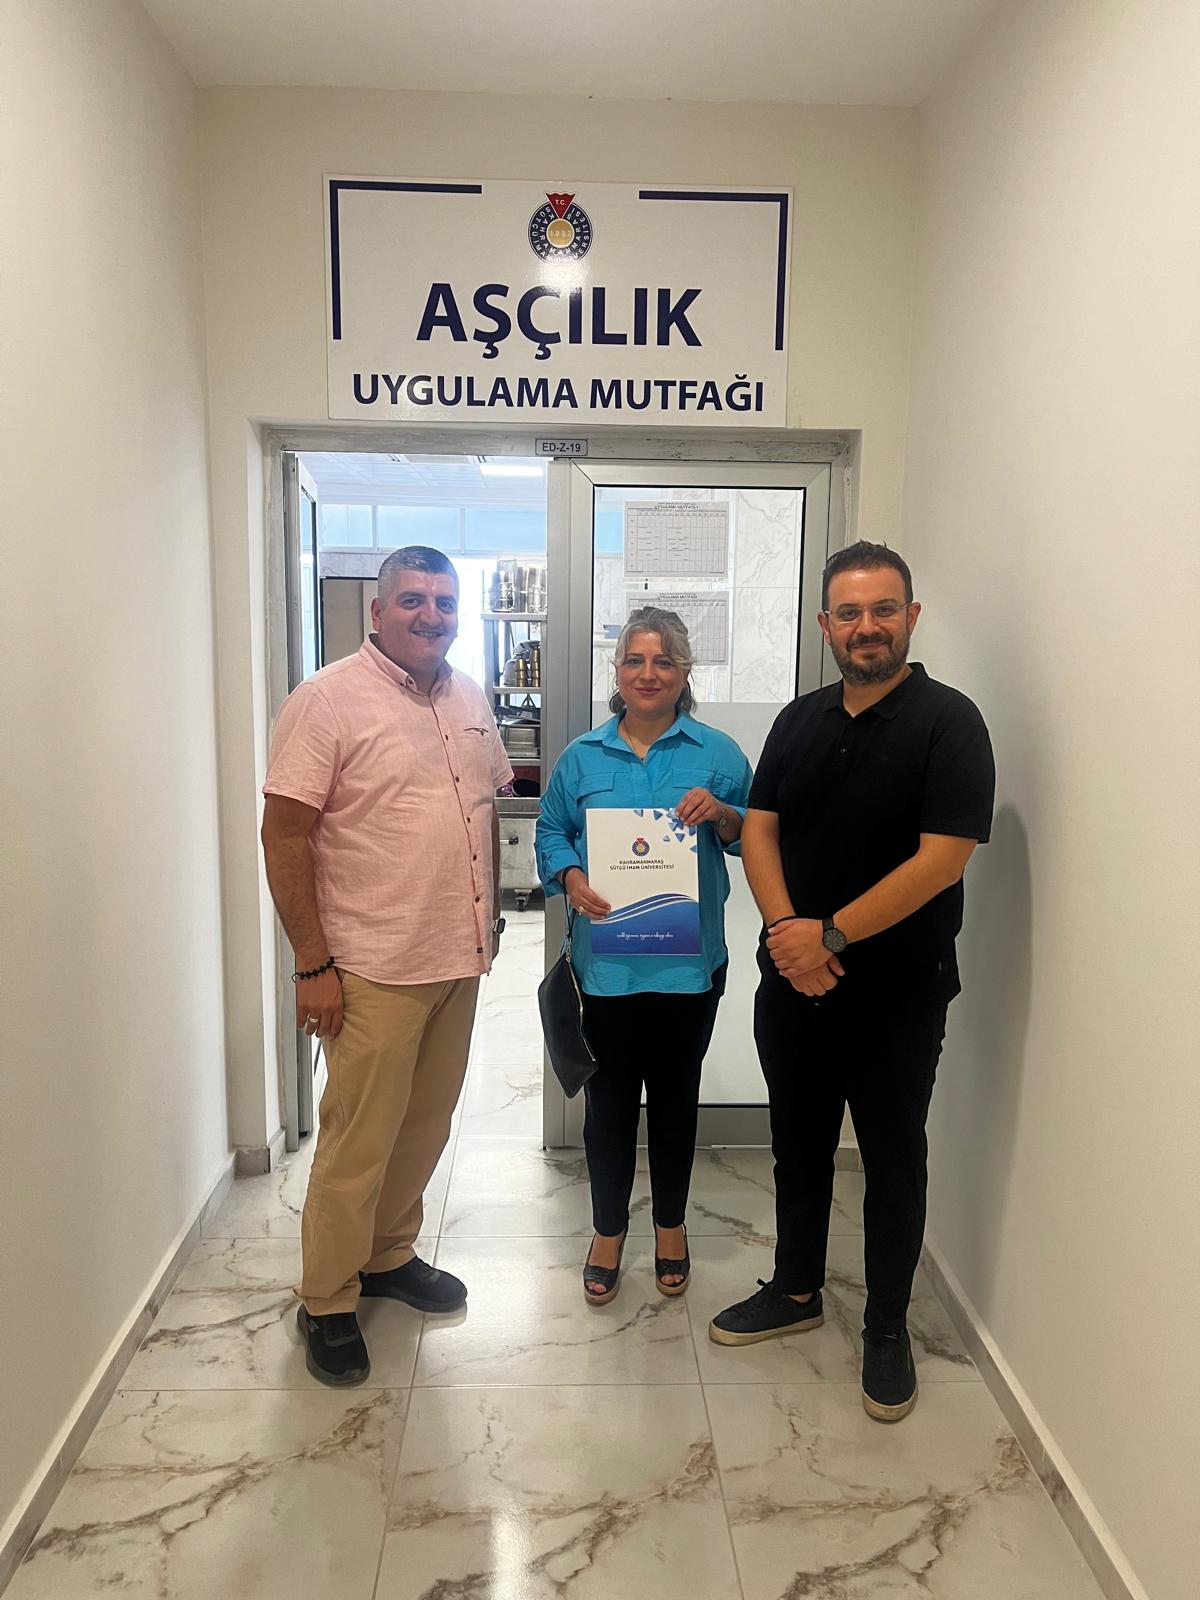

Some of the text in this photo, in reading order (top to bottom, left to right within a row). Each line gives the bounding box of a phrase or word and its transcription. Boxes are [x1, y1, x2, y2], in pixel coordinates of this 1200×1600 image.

[415, 282, 703, 360] AŞÇILIK
[353, 373, 764, 412] UYGULAMA MUTFAĞI
[542, 442, 581, 453] ED-Z-19
